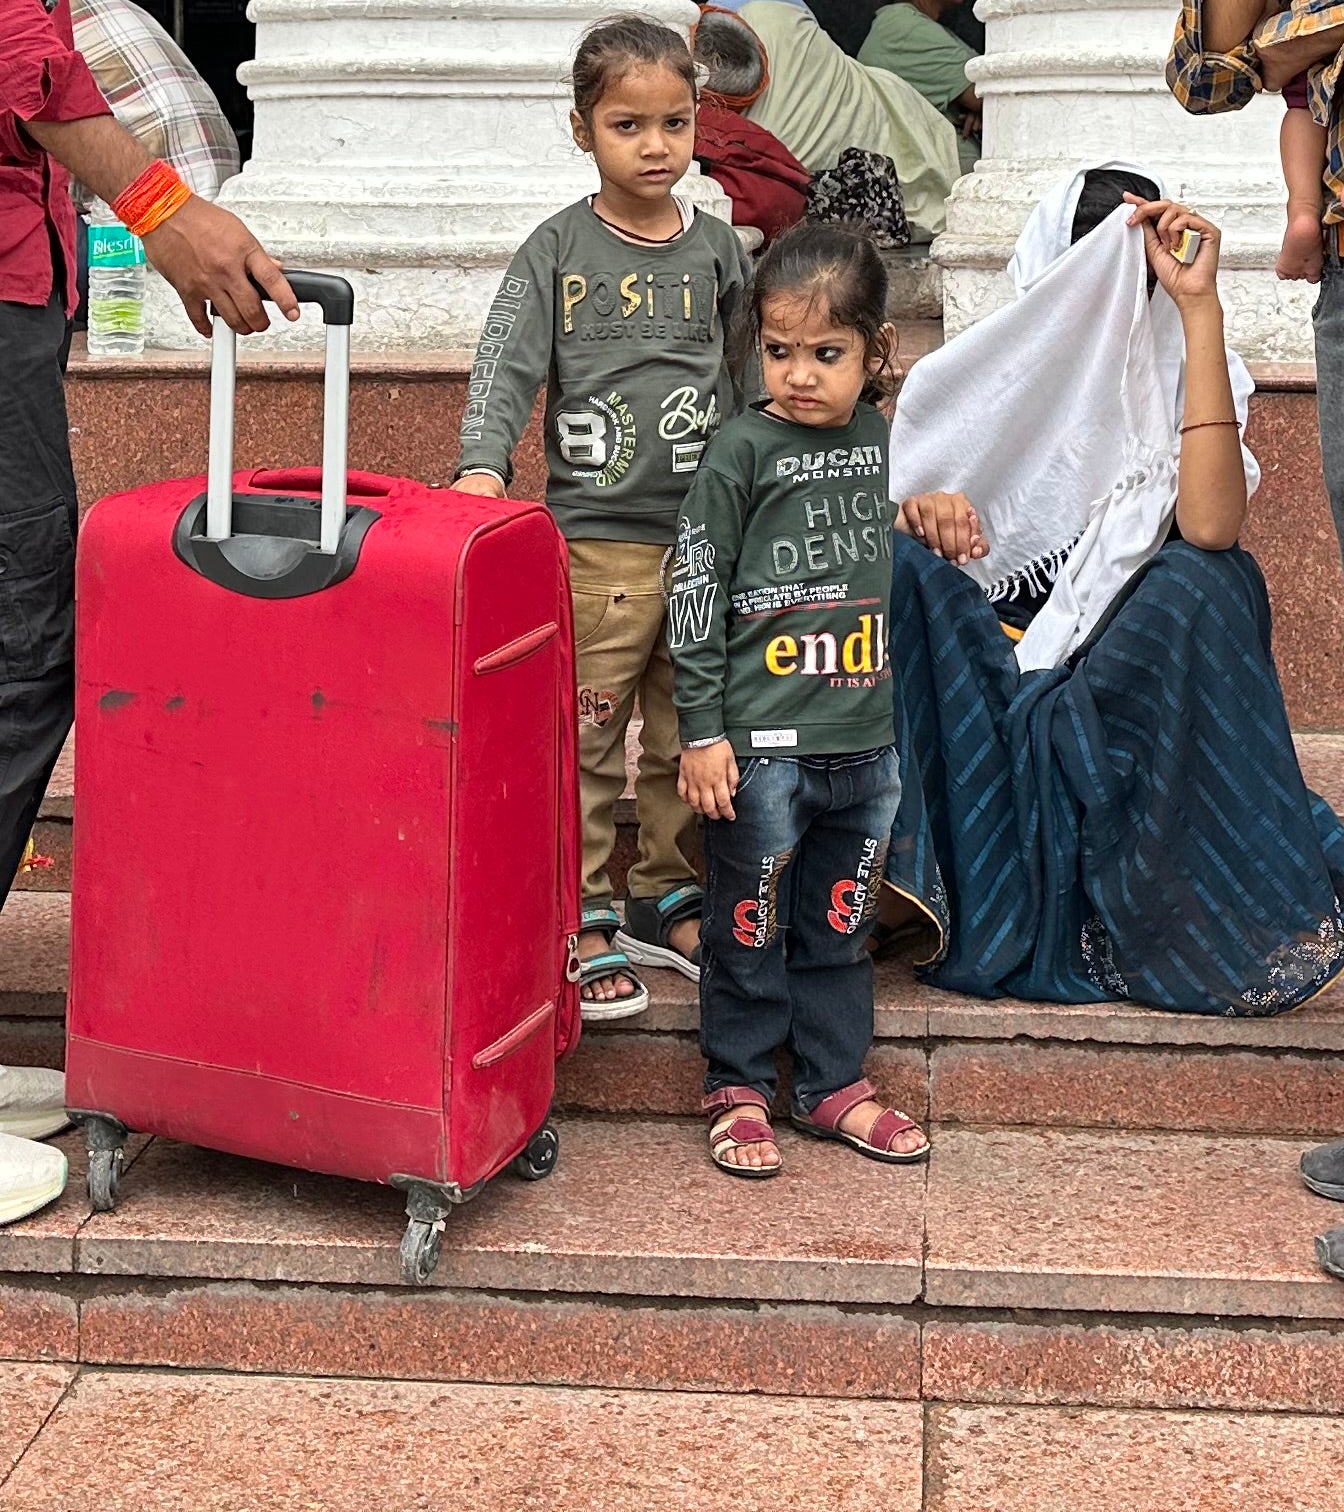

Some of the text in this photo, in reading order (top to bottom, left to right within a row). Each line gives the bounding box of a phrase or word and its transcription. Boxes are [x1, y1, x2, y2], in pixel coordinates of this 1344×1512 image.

[556, 410, 606, 466] 8
[595, 391, 636, 487] MASTERMIND
[776, 446, 882, 476] DUCATI
[792, 465, 880, 483] MONSTER
[780, 583, 805, 593] THAT
[765, 613, 889, 676] endl
[758, 856, 775, 897] STYLE
[857, 838, 877, 879] STYLE
